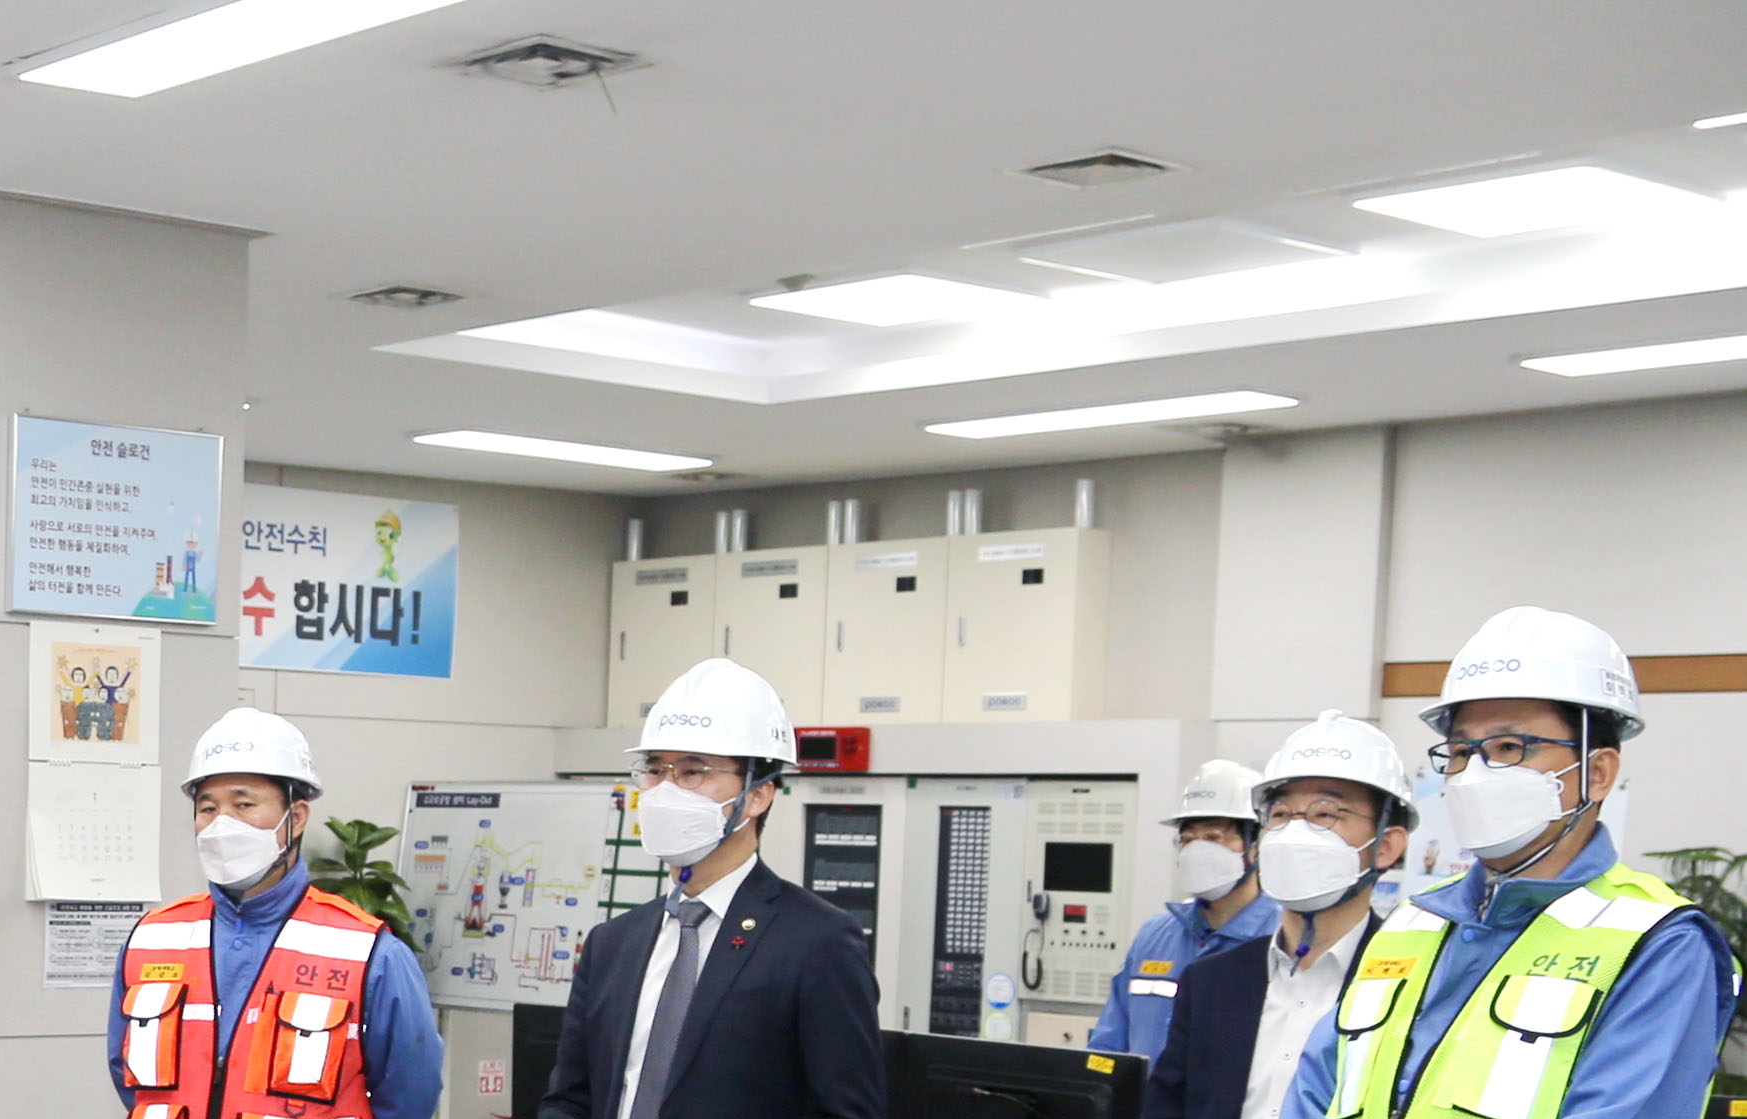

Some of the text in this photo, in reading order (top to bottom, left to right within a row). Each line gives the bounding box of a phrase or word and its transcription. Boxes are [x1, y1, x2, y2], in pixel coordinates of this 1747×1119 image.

[90, 439, 151, 461] 안전 슬로건
[31, 458, 57, 472] 우리는
[31, 476, 56, 489] 안전이
[124, 484, 141, 497] 위한
[31, 494, 56, 506] 최고의
[30, 519, 64, 532] 사랑으로
[67, 522, 92, 534] 서로의
[95, 524, 120, 538] 안전을
[242, 519, 328, 557] 안전수칙
[30, 536, 55, 550] 안전한
[29, 561, 64, 575] 안전해서
[242, 575, 422, 647] 수 합시다!
[659, 713, 713, 729] posco
[205, 741, 254, 760] posco
[1526, 953, 1601, 983] 안전
[295, 964, 350, 992] 안전
